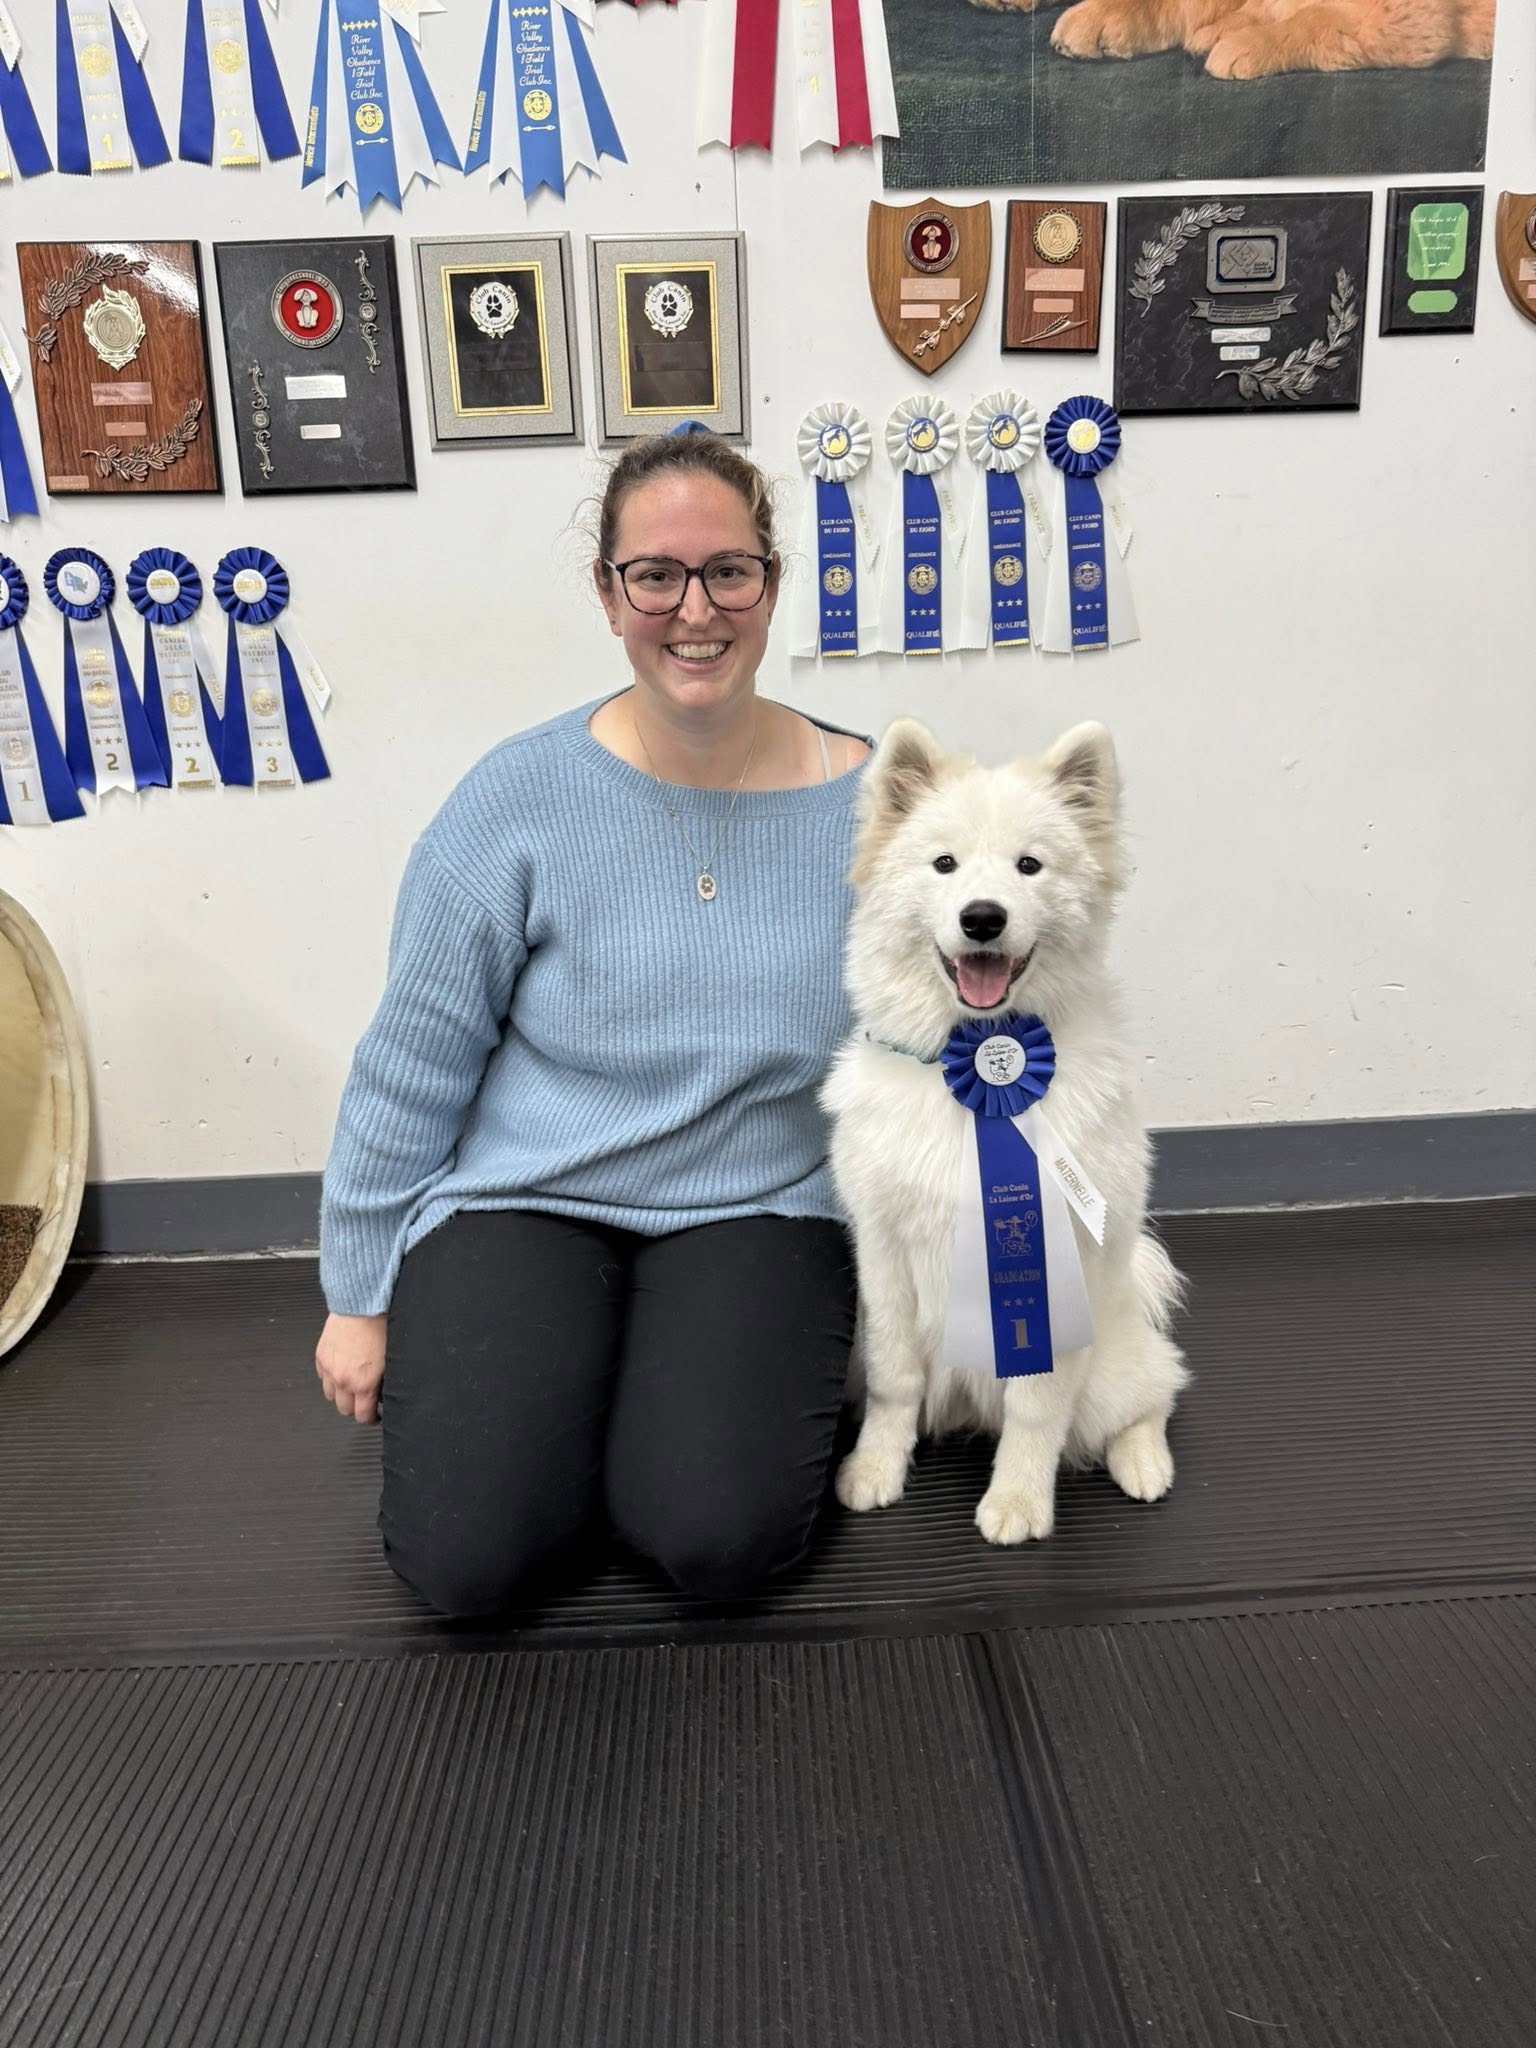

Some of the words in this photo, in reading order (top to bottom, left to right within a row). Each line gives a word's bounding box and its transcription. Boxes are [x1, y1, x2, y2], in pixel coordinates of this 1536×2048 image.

[102, 133, 114, 153] 1
[229, 129, 245, 150] 2
[476, 289, 489, 304] Club
[651, 288, 665, 303] Club
[994, 620, 1029, 630] QUALIFIÉ
[1073, 624, 1107, 636] QUALIFIÉ
[822, 630, 856, 640] QUALIFIÉ
[906, 629, 940, 639] QUALIFIÉ
[105, 752, 120, 771] 2
[185, 756, 201, 774] 2
[267, 756, 279, 773] 3
[17, 779, 35, 802] 1
[992, 1184, 1008, 1193] Club
[1009, 1184, 1029, 1192] Canin
[1055, 1157, 1095, 1208] MATERNELLE
[1010, 1317, 1032, 1350] 1
